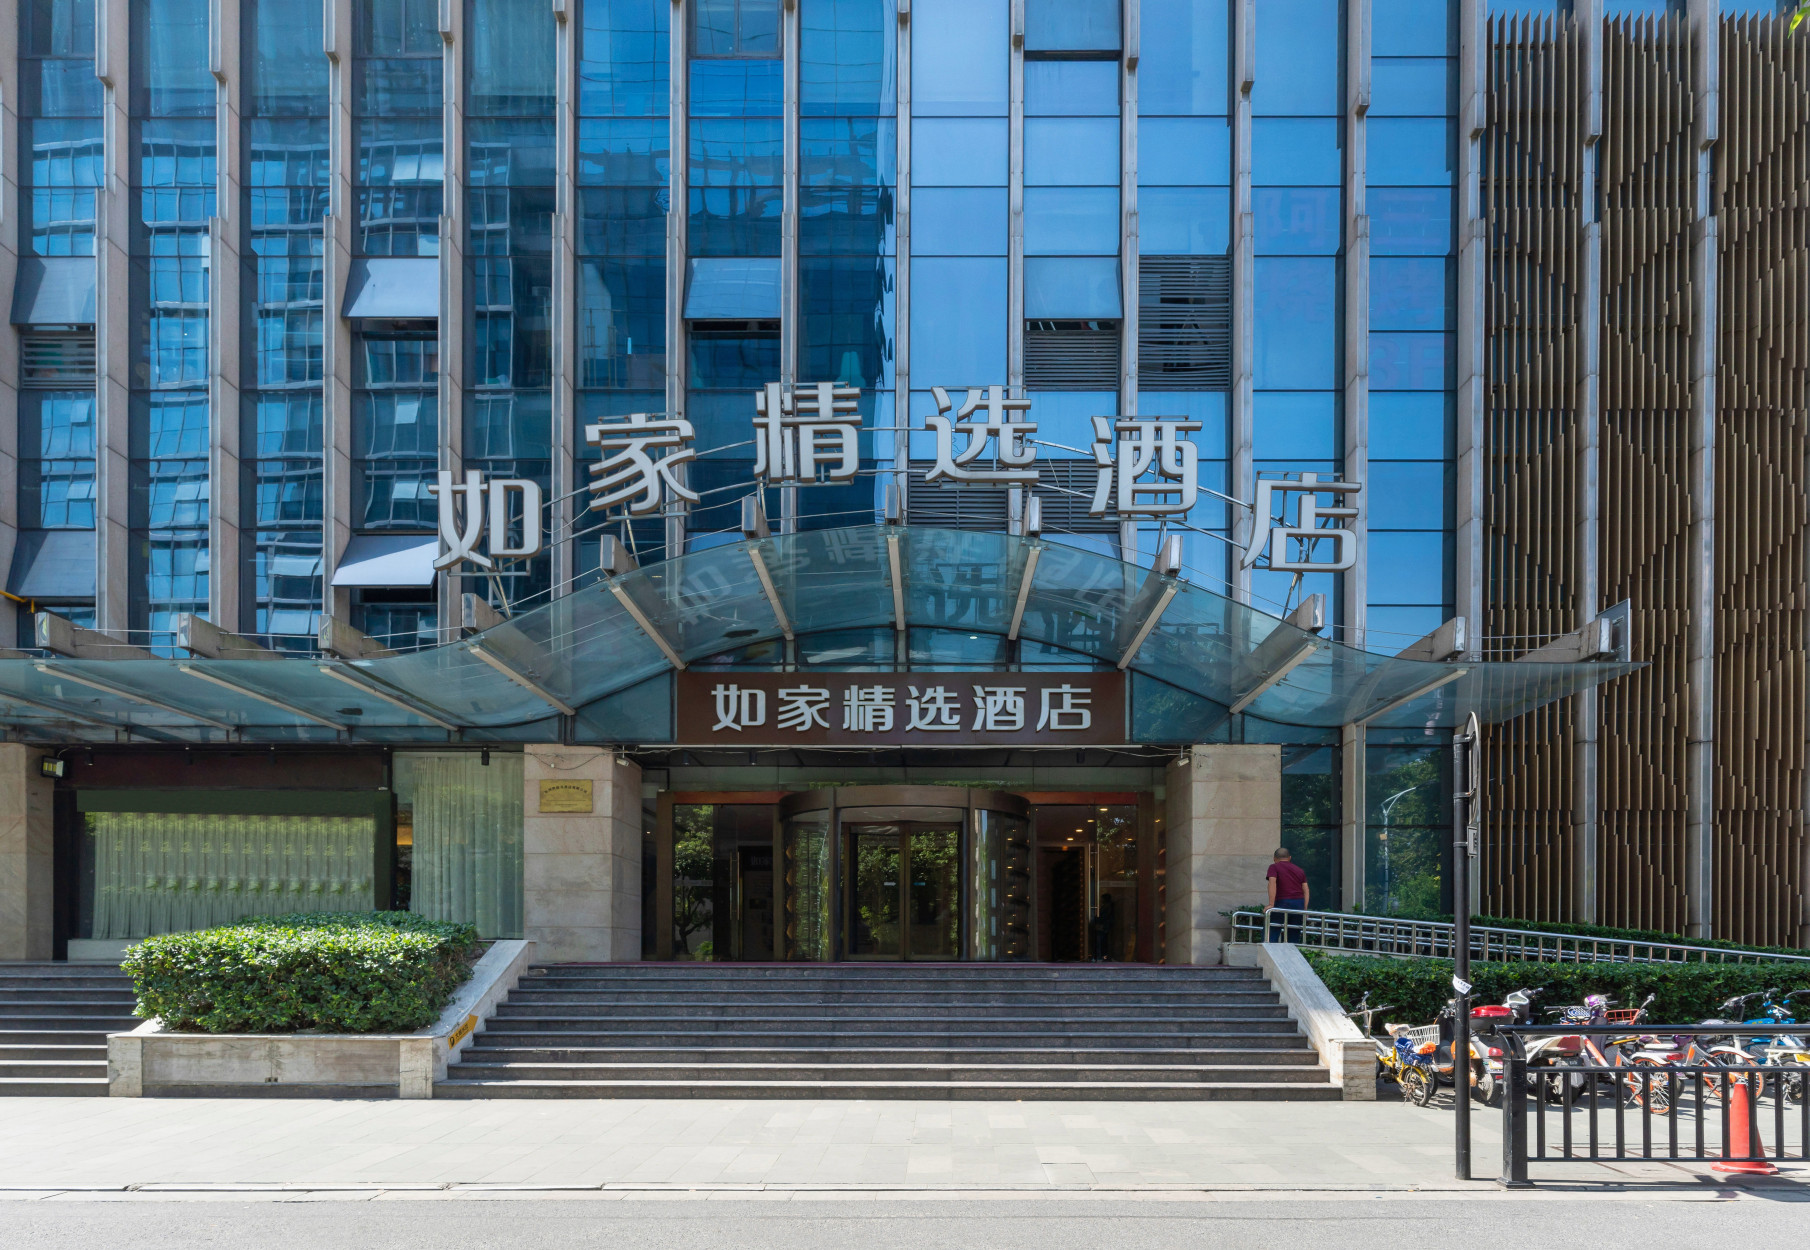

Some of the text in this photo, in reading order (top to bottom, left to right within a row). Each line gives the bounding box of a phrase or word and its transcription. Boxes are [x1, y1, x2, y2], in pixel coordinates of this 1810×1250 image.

[427, 381, 1363, 573] 如家精选酒店
[711, 683, 1093, 733] 如家精选酒店
